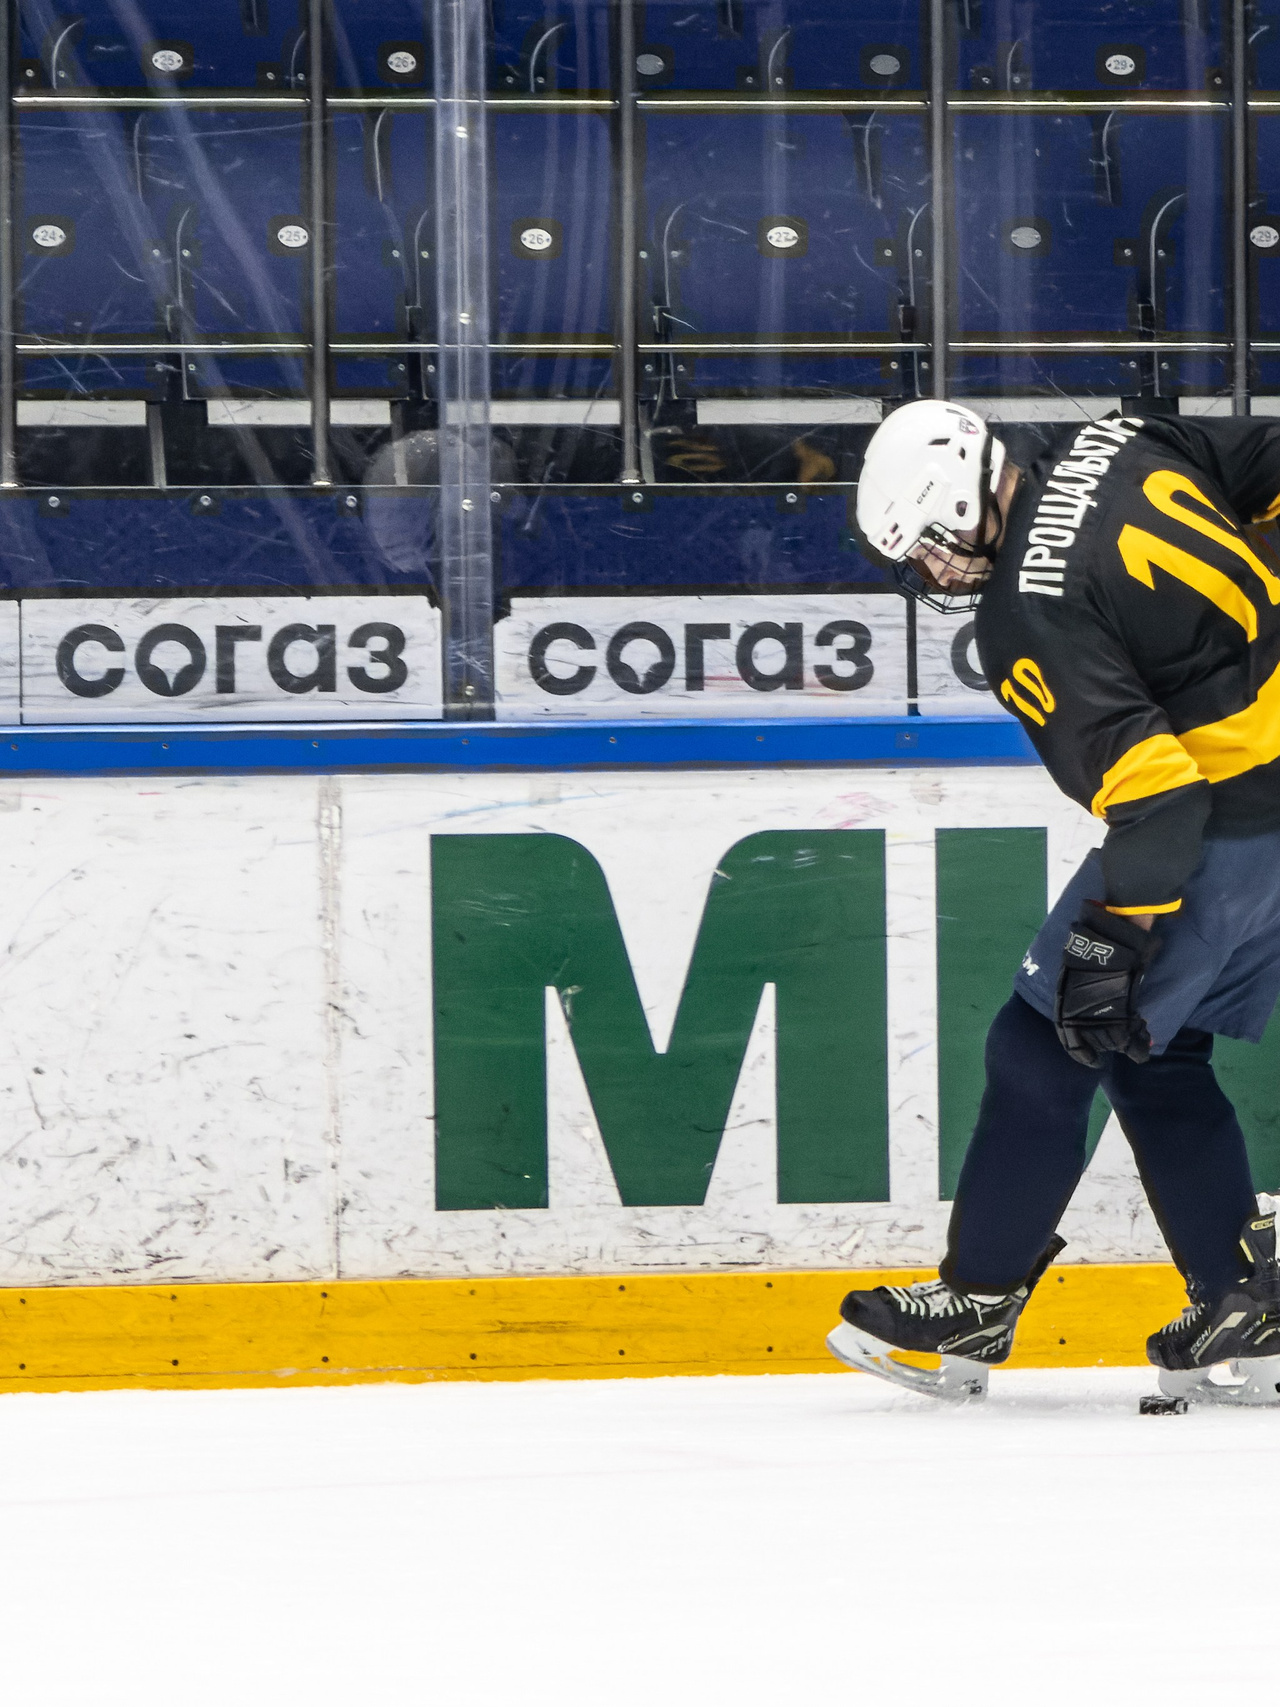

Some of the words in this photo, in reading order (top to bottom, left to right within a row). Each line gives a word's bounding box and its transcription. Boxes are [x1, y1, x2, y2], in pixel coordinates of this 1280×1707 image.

[917, 480, 935, 505] CCM
[1000, 658, 1056, 727] 10
[1190, 1329, 1210, 1354] CCM
